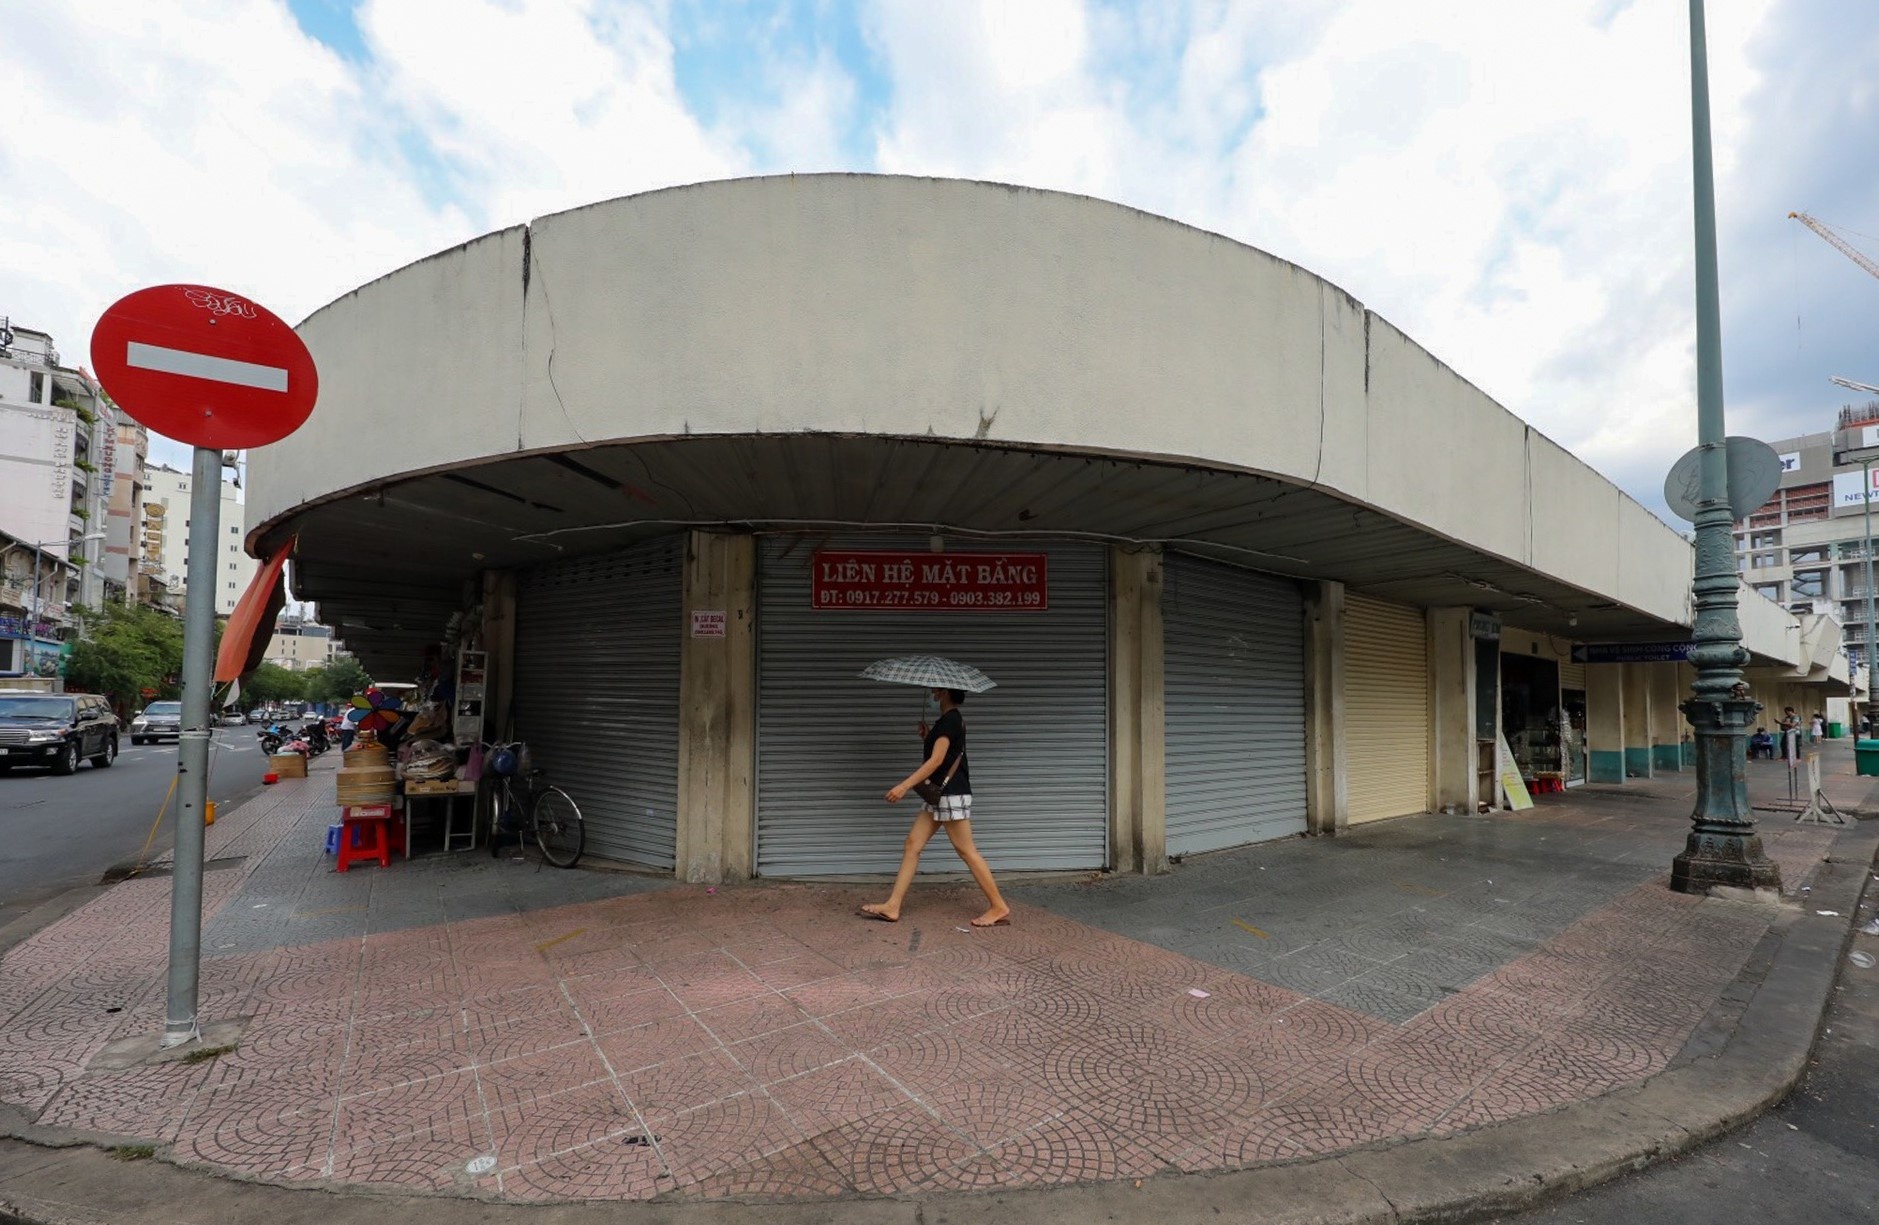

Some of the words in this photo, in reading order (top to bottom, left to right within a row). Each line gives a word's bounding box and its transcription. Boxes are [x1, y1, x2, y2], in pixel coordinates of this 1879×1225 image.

[822, 559, 876, 583] LIÊN
[882, 559, 915, 588] HỆ
[921, 559, 971, 590] MẶT
[820, 590, 843, 604] ĐT:
[846, 590, 938, 605] 0917.277.579
[949, 591, 1041, 606] 0903.382.199
